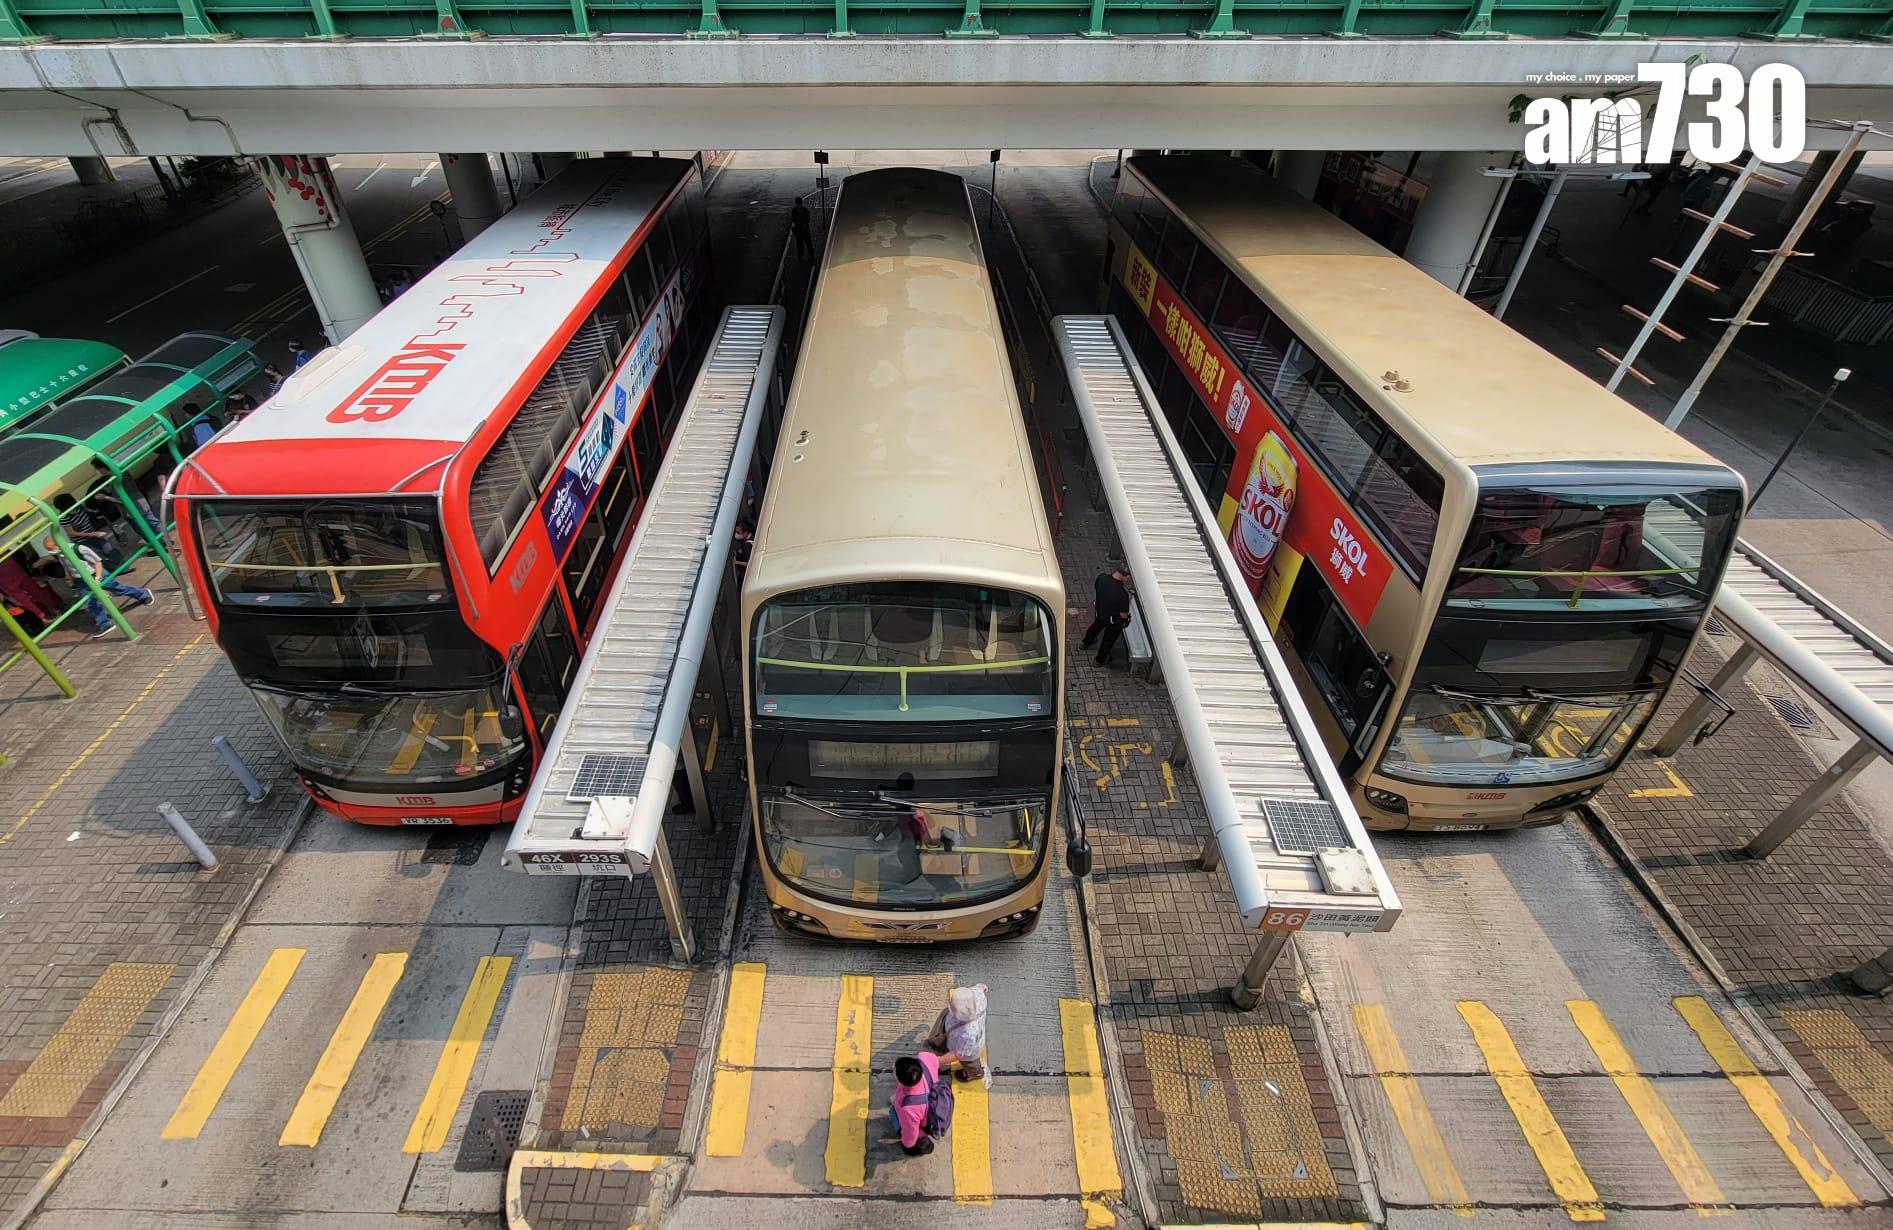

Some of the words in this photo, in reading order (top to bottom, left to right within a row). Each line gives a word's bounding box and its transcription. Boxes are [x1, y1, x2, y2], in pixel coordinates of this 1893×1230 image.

[1131, 256, 1152, 303] 新裝
[326, 343, 467, 424] KMB
[1241, 488, 1282, 537] SKOL
[1329, 546, 1353, 584] 獅威
[1330, 517, 1368, 577] SKOL
[508, 540, 538, 597] KMB
[395, 796, 436, 805] KMB
[531, 854, 566, 863] 46X
[579, 854, 621, 863] 293S
[592, 864, 616, 872] 坑口
[1267, 912, 1304, 926] 86
